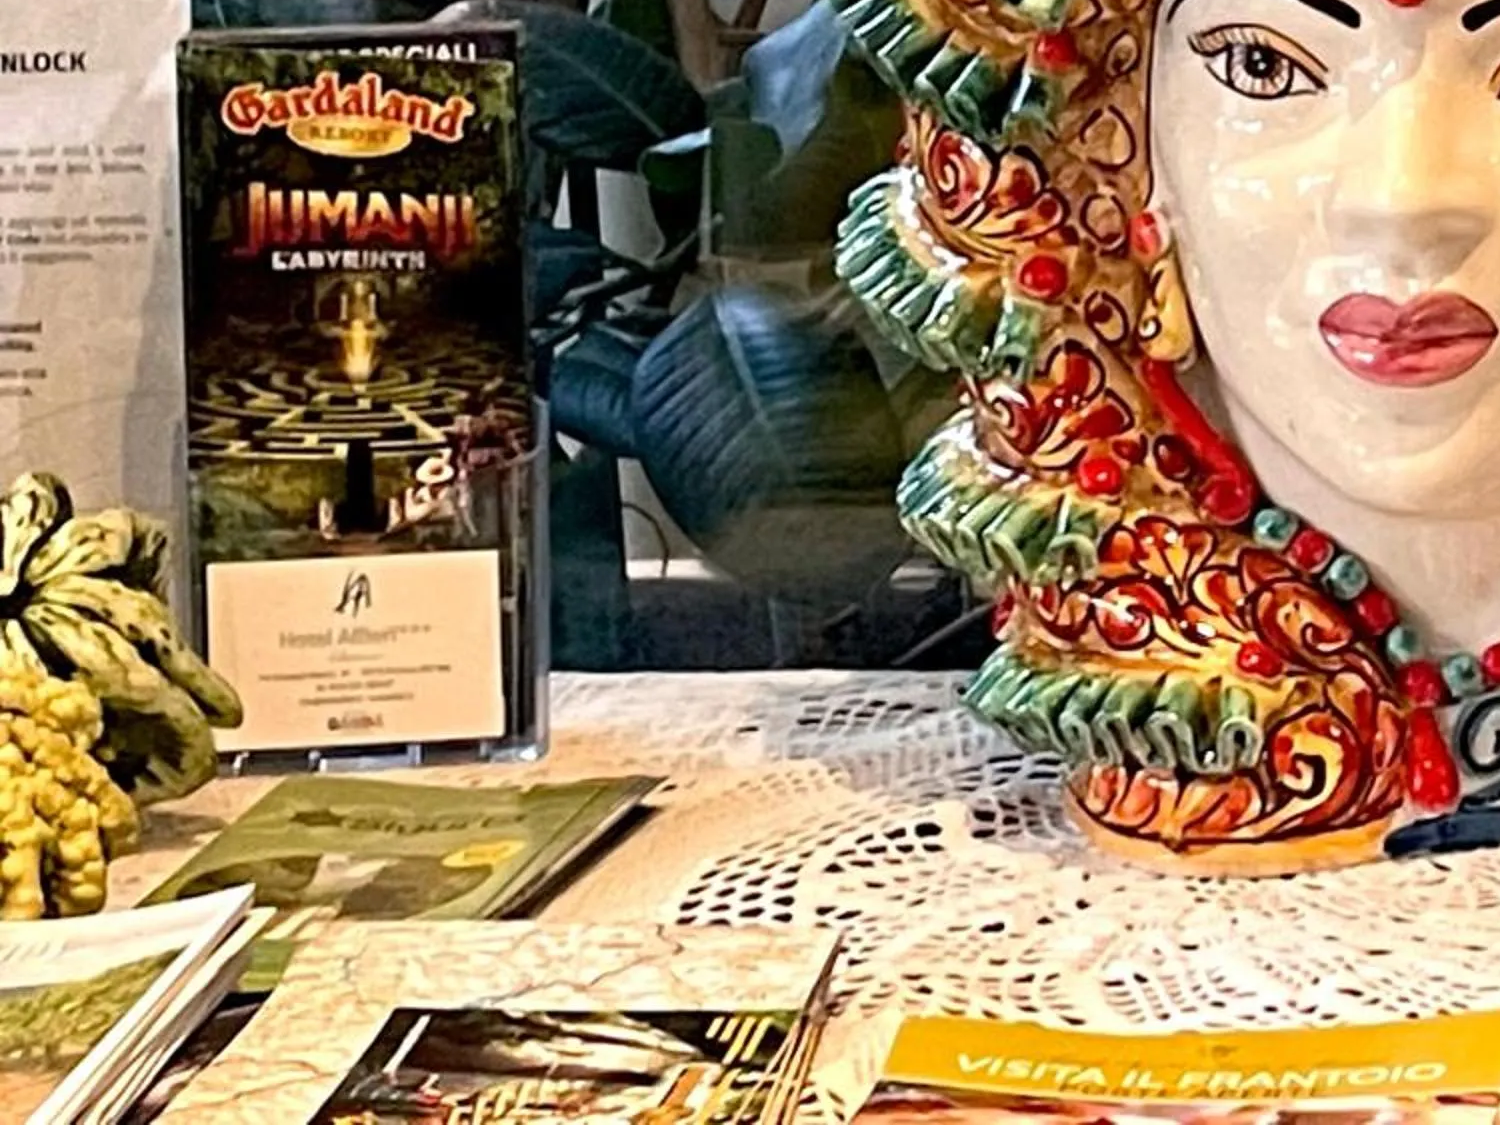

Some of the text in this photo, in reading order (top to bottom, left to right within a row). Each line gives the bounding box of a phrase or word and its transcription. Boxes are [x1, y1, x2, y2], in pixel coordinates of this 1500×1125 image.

[222, 72, 475, 142] Gardaland
[233, 181, 476, 259] JUMANJI
[271, 250, 426, 271] LABYRINTH
[956, 1052, 1449, 1090] VISITA IL FRANTOIO
